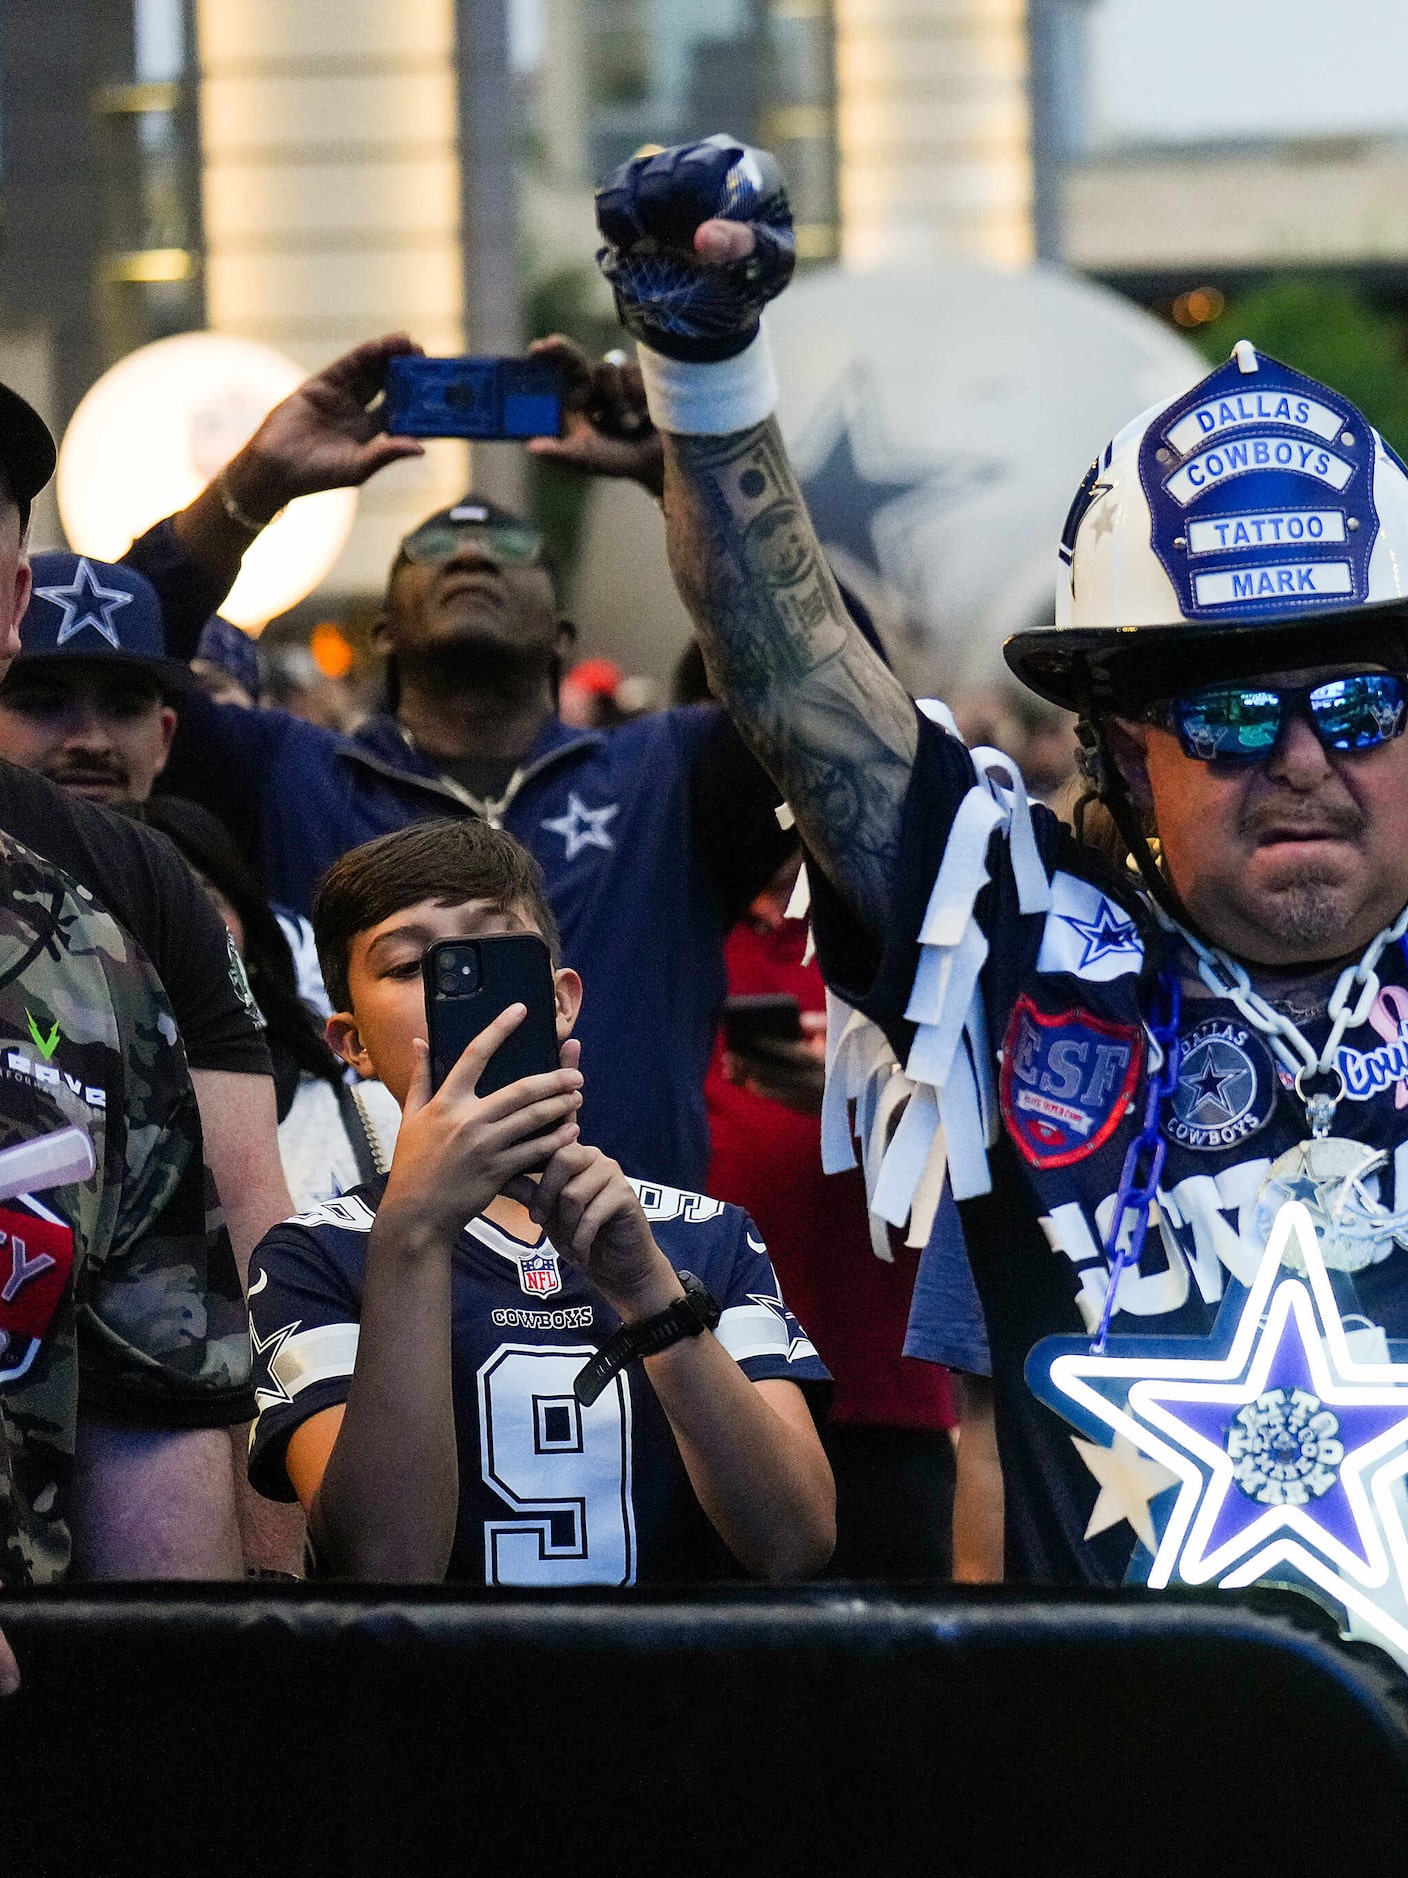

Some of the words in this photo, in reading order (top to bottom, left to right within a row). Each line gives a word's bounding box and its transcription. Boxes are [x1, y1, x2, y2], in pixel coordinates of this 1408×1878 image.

[1196, 394, 1311, 434] DALLAS
[1187, 440, 1331, 487] COWBOYS
[1214, 516, 1324, 546] TATTOO
[1231, 568, 1317, 598] MARK
[1181, 1022, 1250, 1056] DALLAS
[1012, 1015, 1130, 1106] ESF
[1166, 1112, 1260, 1146] COWBOYS
[526, 1271, 556, 1291] NFL
[491, 1305, 594, 1330] COWBOYS
[476, 1343, 637, 1587] 9
